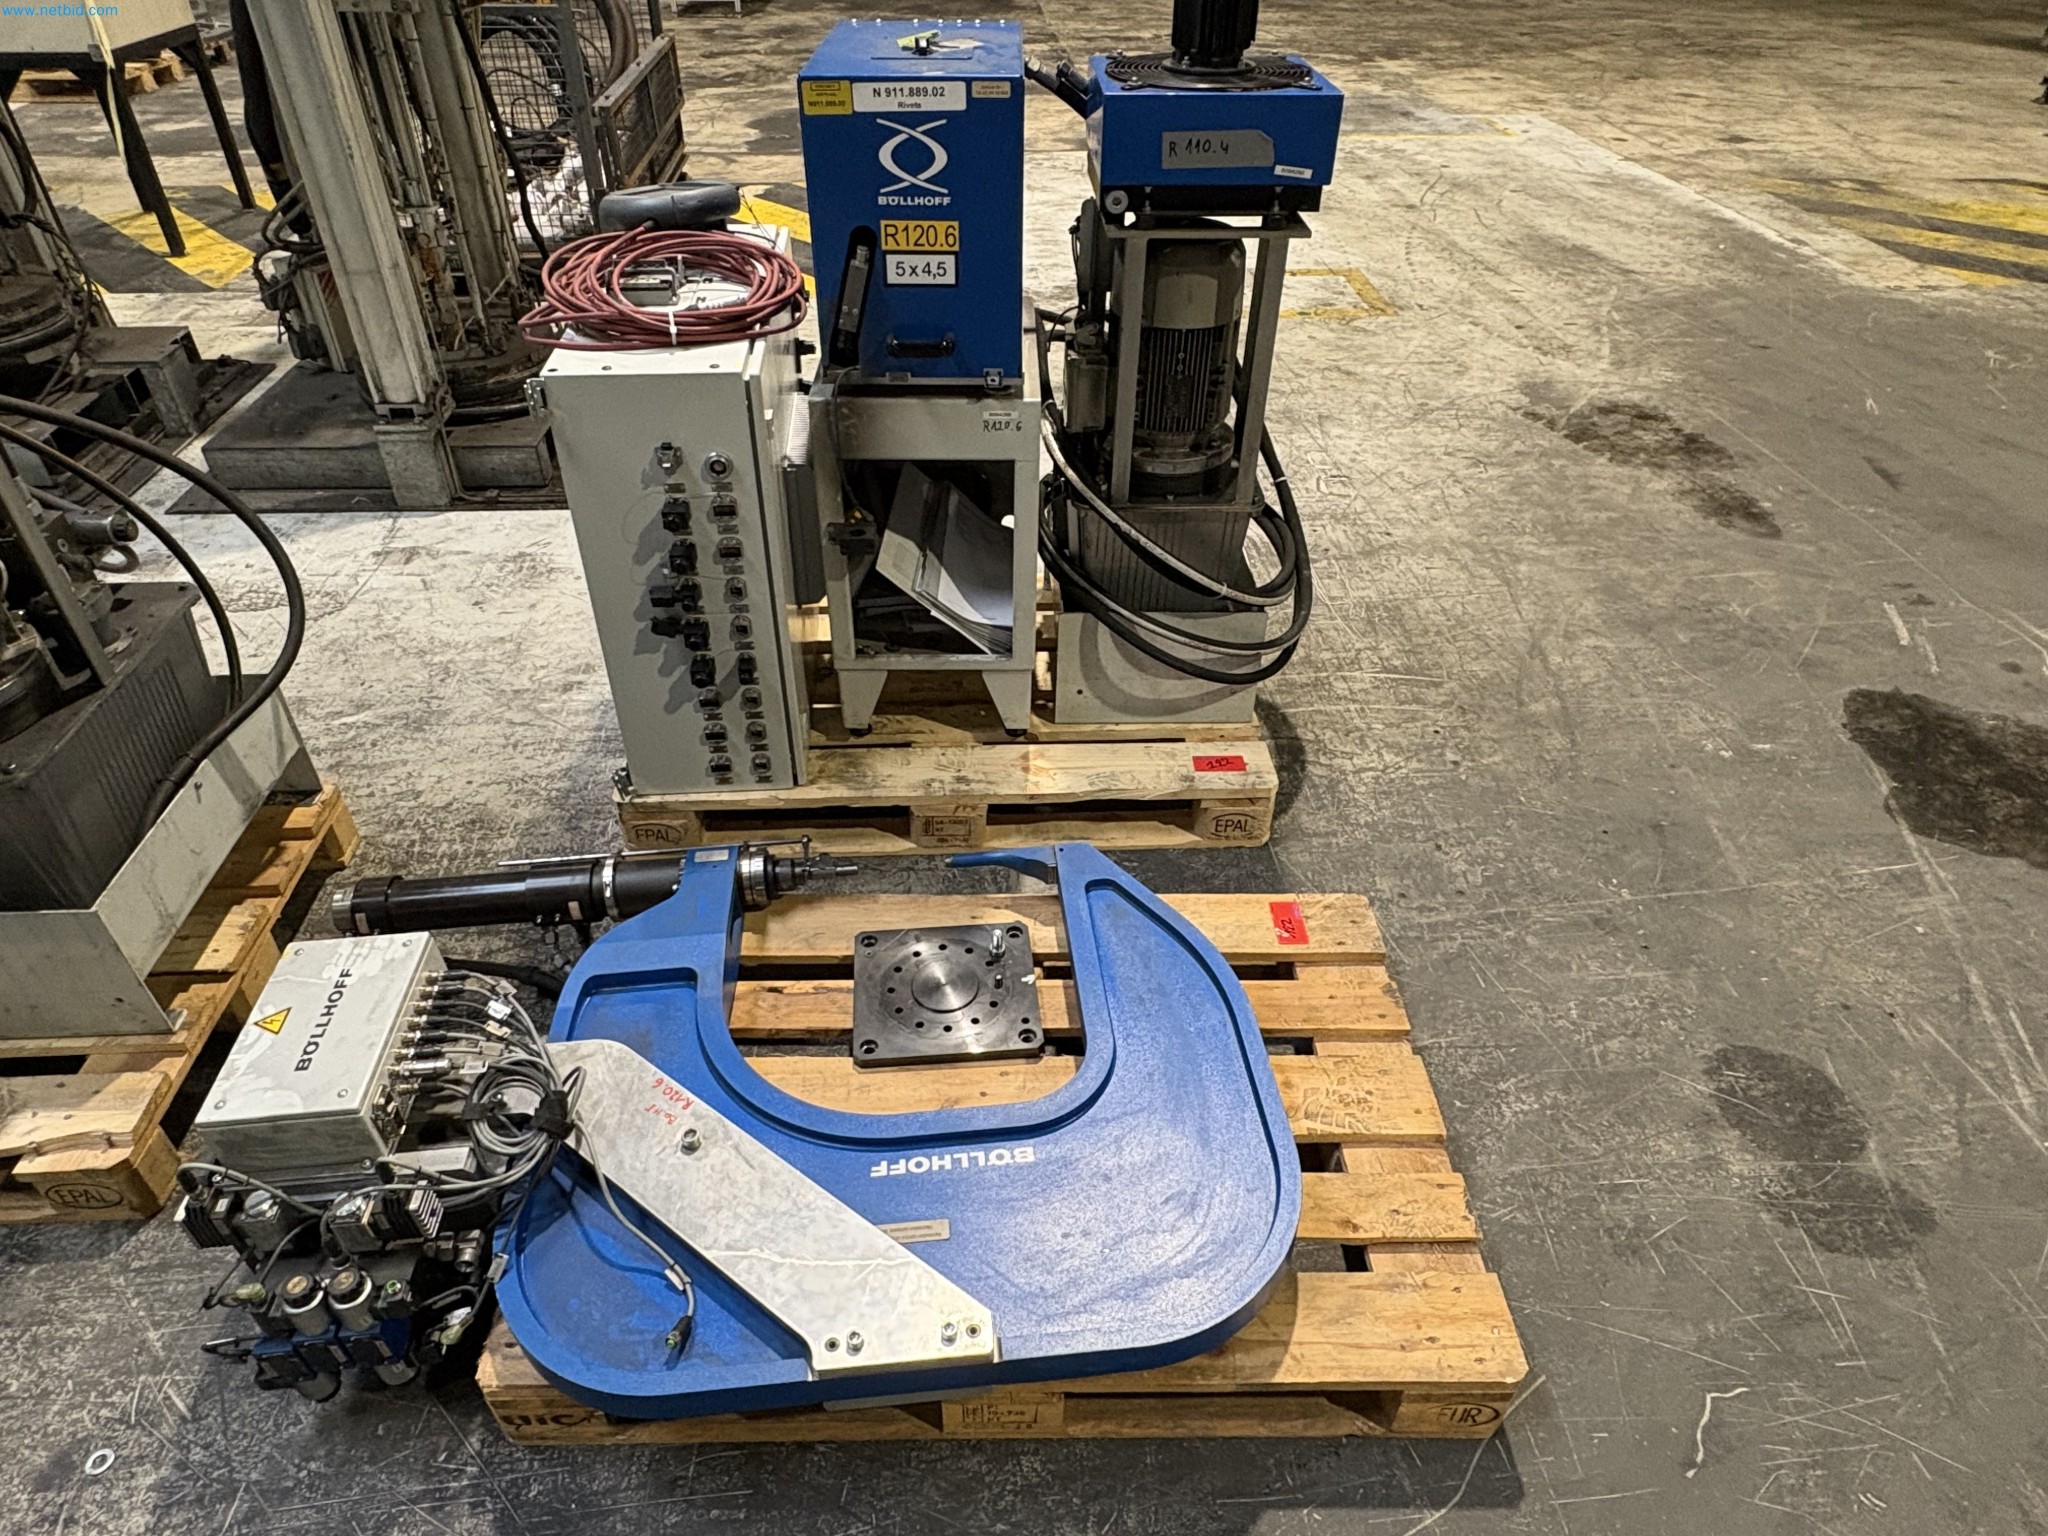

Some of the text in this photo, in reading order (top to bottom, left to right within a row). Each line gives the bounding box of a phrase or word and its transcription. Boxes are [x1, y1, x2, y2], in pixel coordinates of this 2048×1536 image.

[872, 86, 946, 98] N 911.889.02
[897, 101, 922, 110] Rivets
[1168, 138, 1229, 157] R 110.4
[883, 224, 957, 248] R120.6
[895, 261, 947, 280] 5 x 4,5
[1214, 819, 1252, 833] EPAL
[54, 1188, 112, 1204] EPAL
